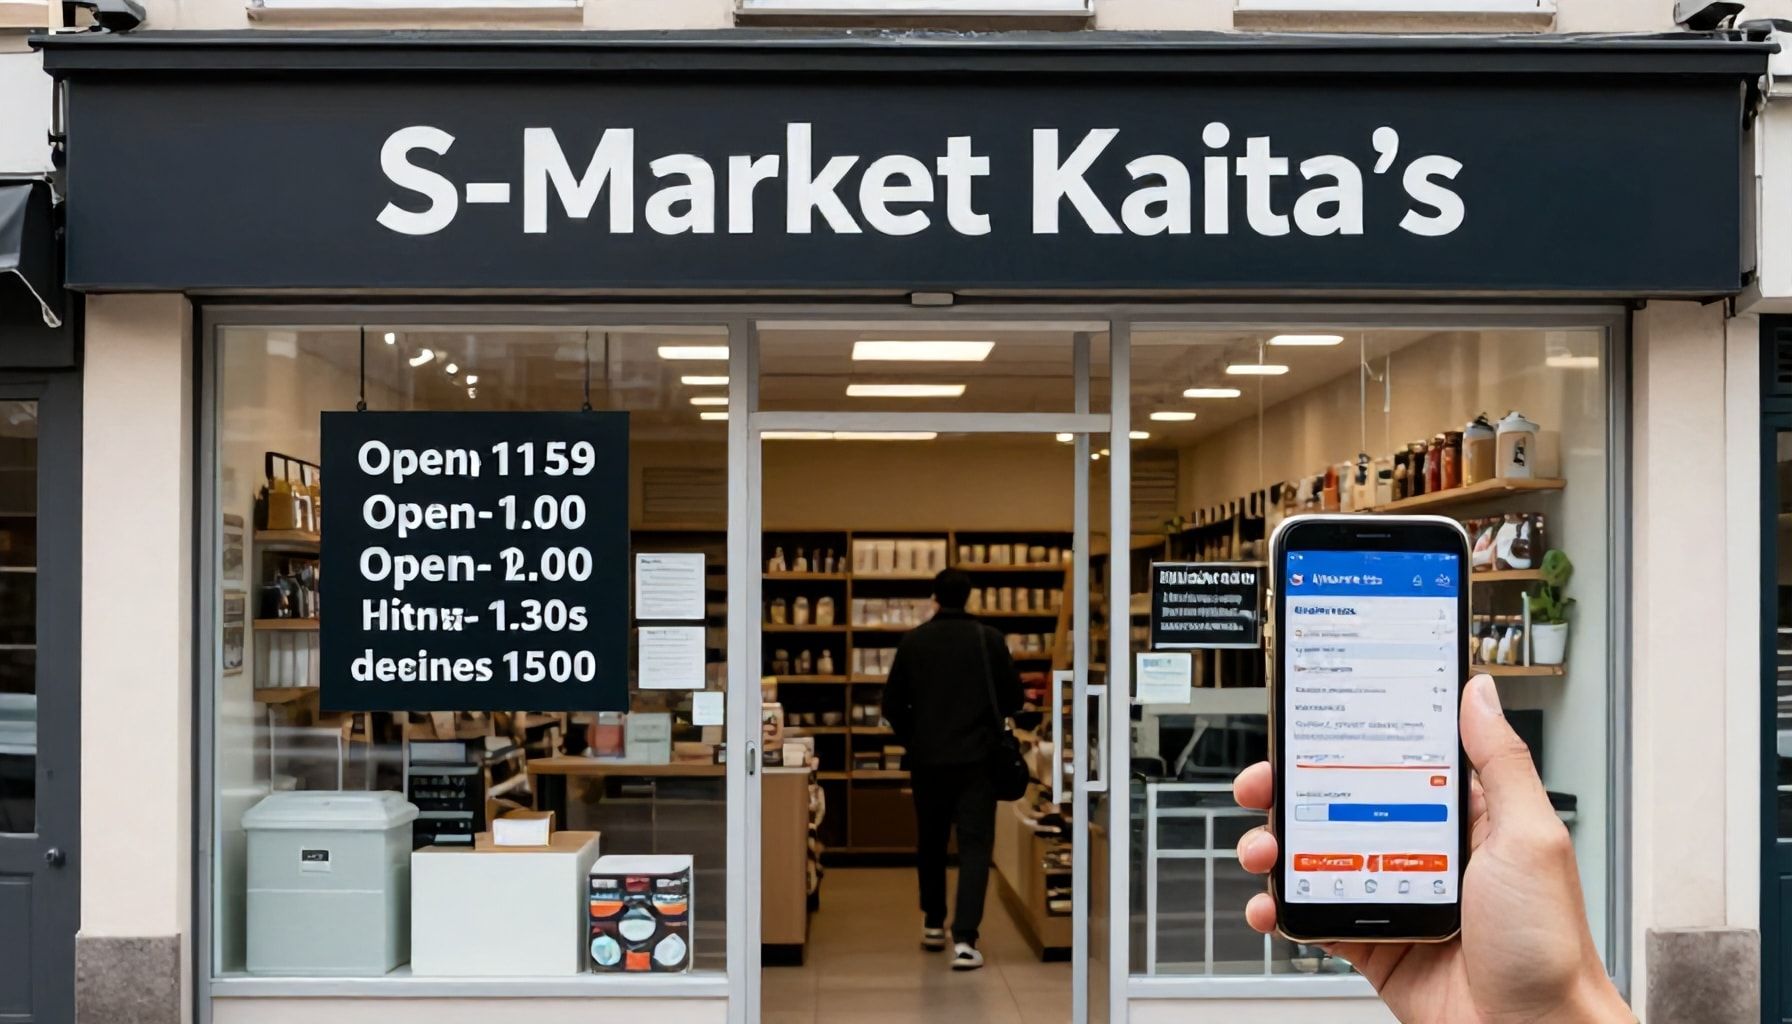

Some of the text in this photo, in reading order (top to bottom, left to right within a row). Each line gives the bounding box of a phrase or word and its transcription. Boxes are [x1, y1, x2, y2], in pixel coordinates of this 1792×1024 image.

[376, 121, 1465, 237] S-Market Kaita's
[487, 598, 589, 632] 1.30s
[502, 649, 596, 683] 1500
